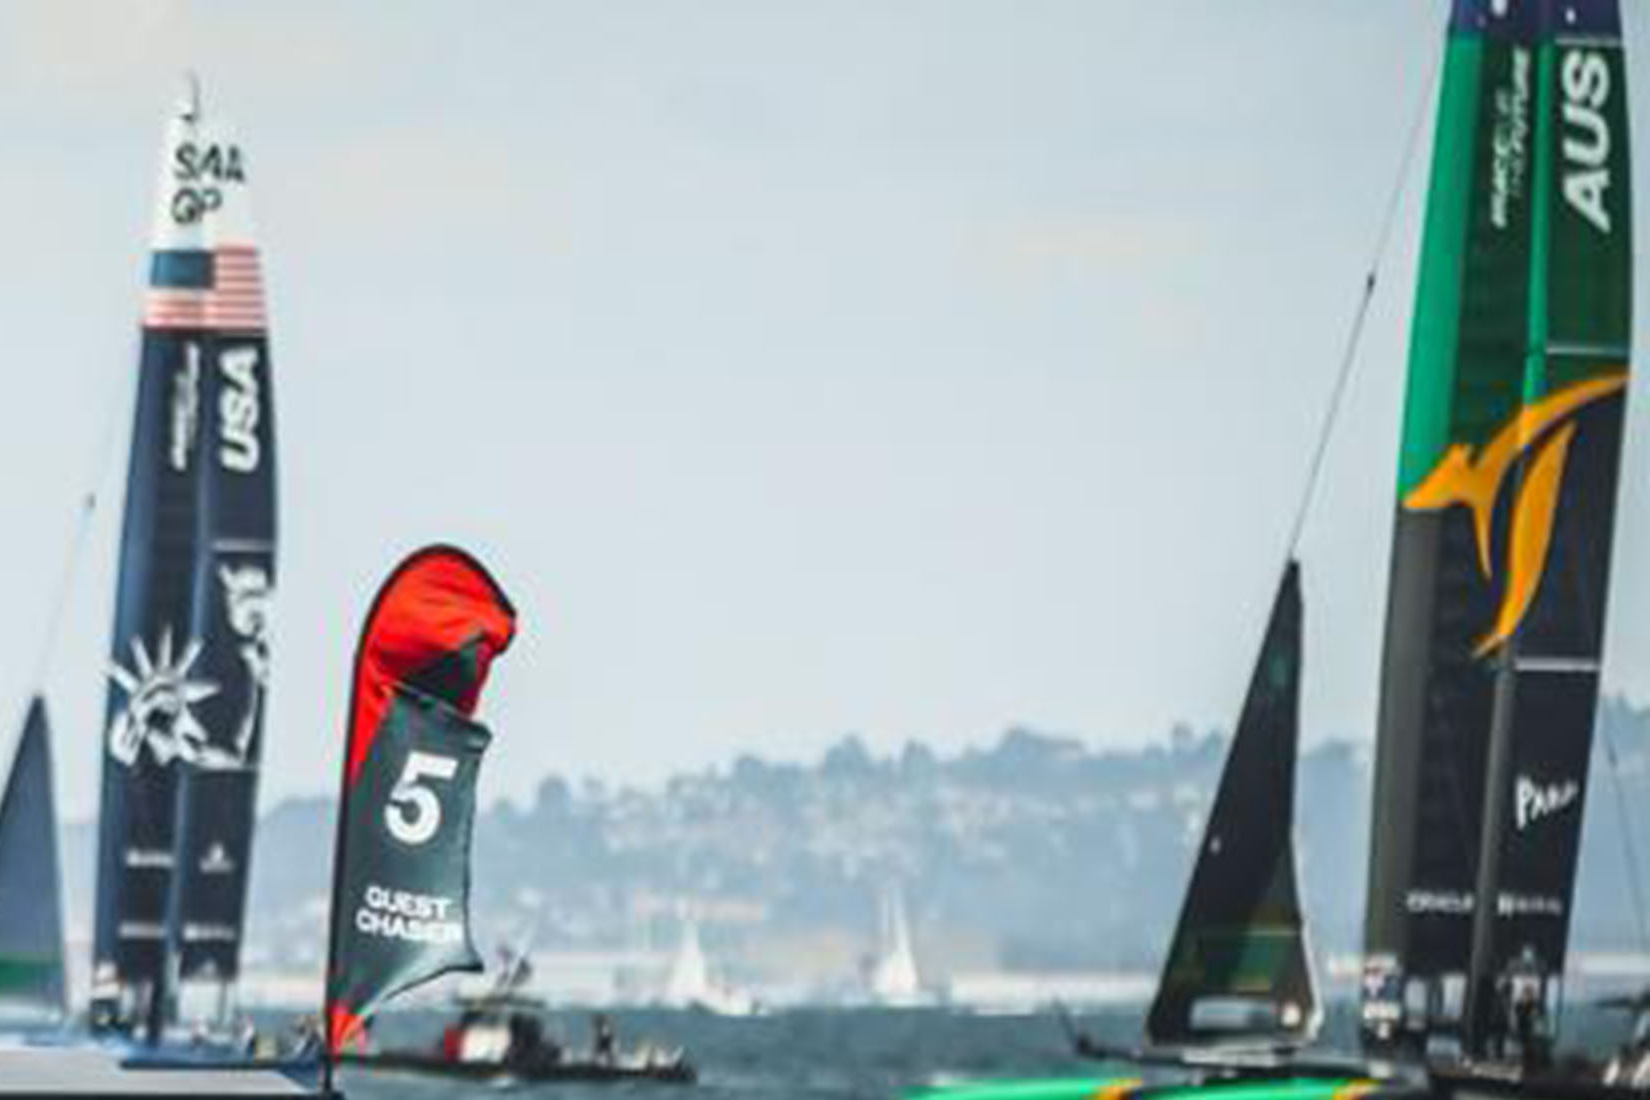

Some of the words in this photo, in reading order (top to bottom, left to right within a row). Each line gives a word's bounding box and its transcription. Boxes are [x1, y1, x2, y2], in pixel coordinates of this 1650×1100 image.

[1562, 49, 1611, 232] AUS
[218, 347, 261, 473] USA
[385, 751, 458, 844] 5
